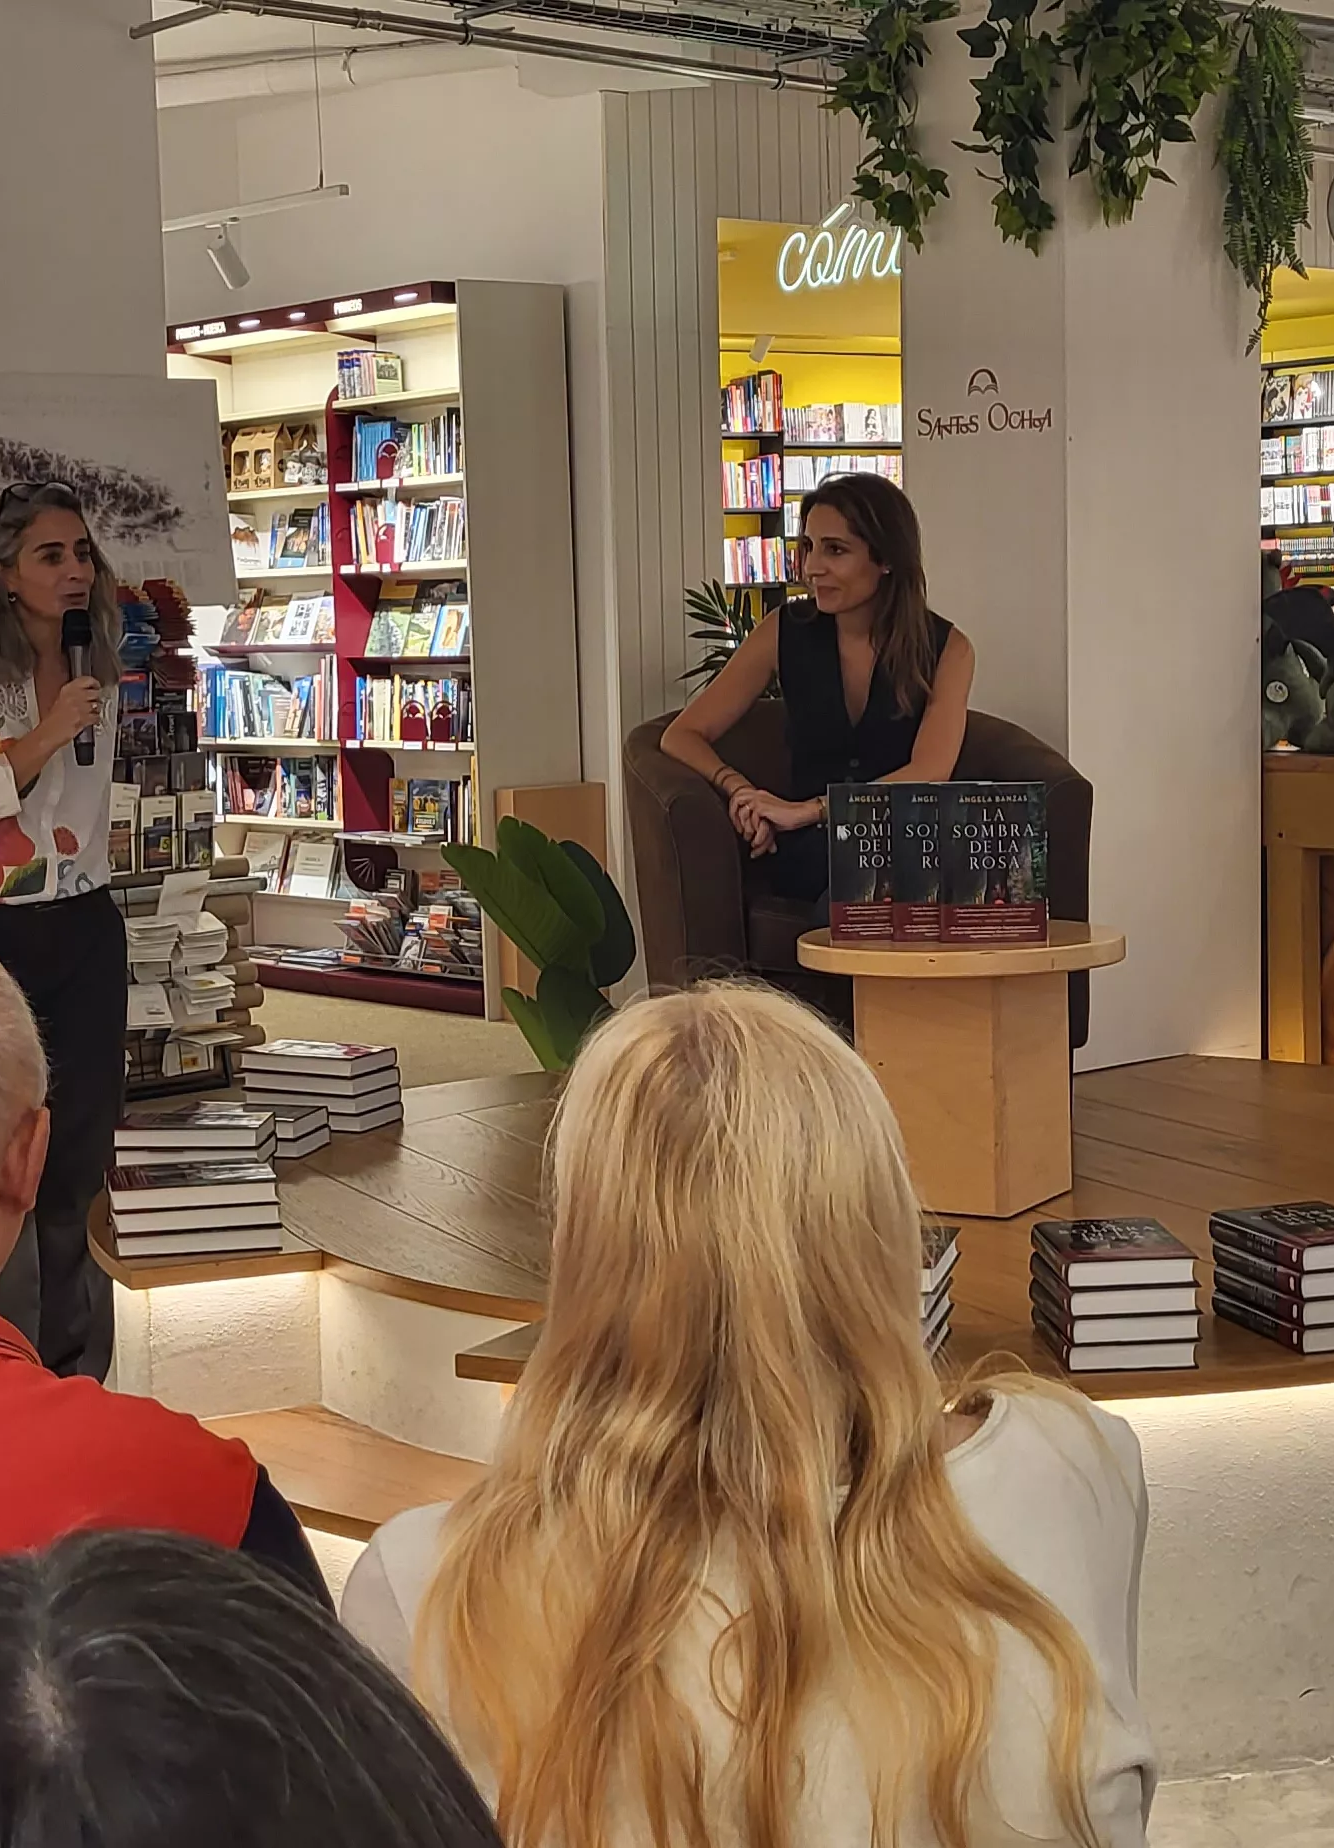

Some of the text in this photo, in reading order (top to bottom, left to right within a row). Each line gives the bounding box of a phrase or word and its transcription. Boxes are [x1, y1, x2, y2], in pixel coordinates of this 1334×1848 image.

[849, 793, 882, 802] ÁNGELA
[959, 794, 992, 803] ÁNGELA
[983, 808, 1005, 821] LA
[952, 823, 1034, 838] SOMBRA
[859, 839, 881, 852] DE
[970, 840, 1019, 853] DE LA
[970, 856, 1020, 870] ROSA
